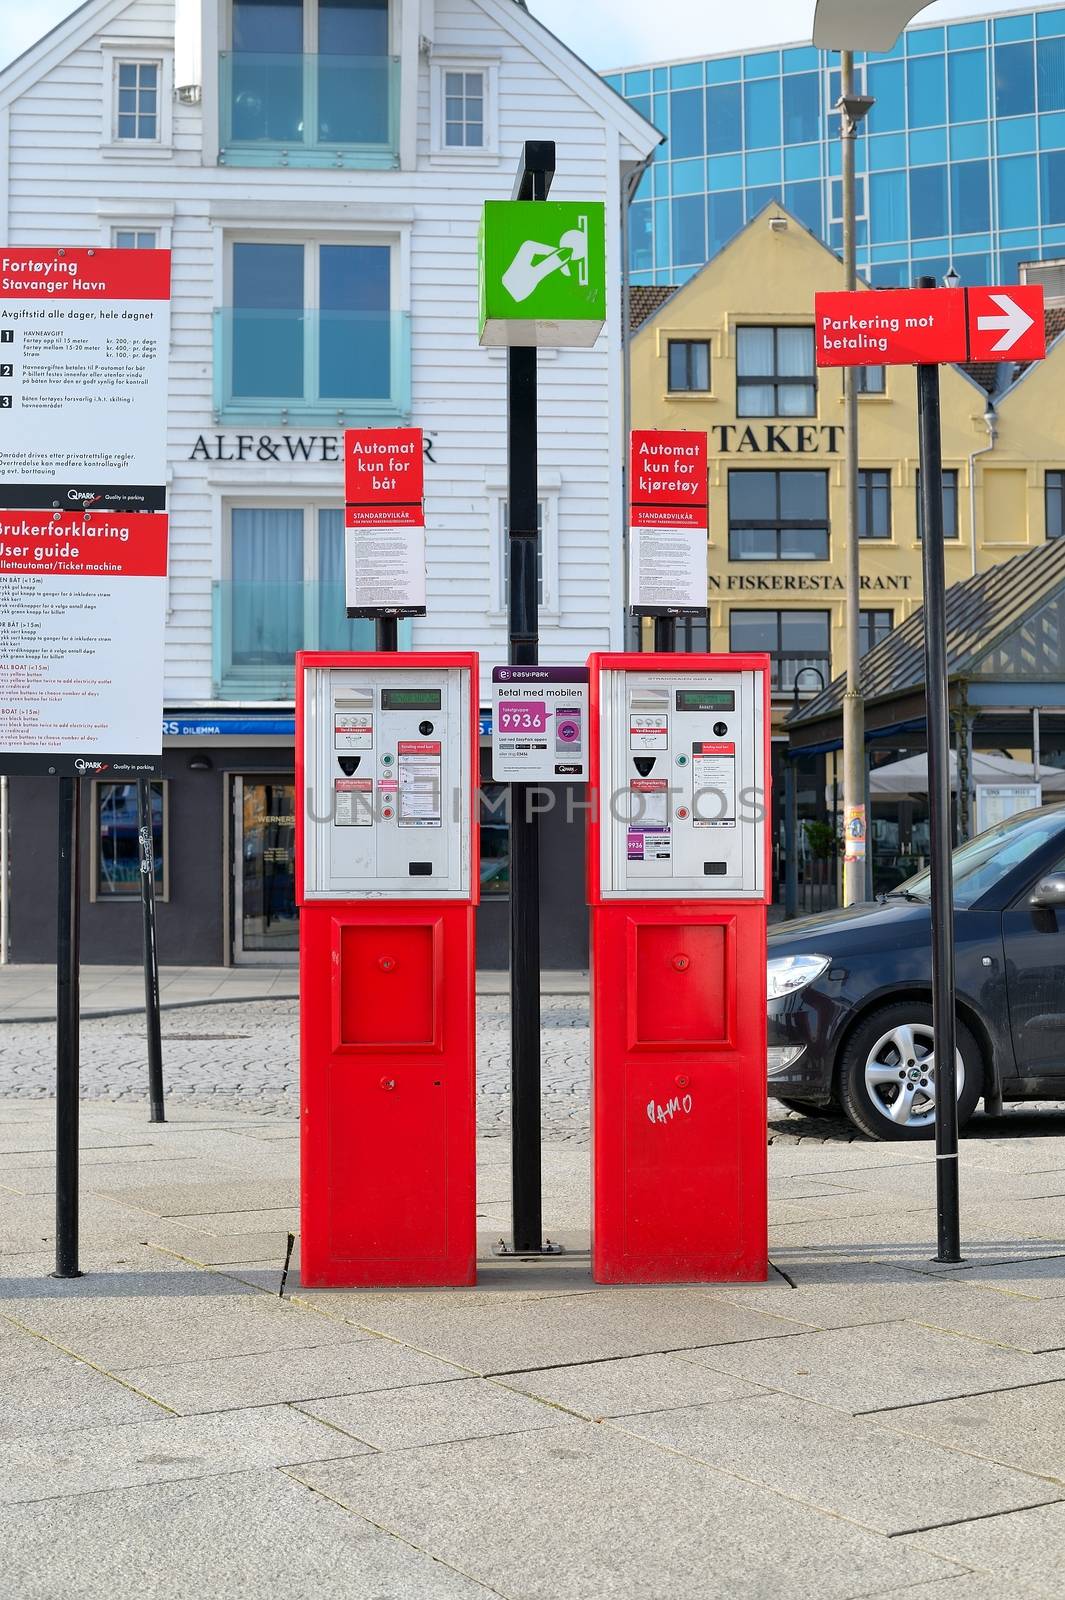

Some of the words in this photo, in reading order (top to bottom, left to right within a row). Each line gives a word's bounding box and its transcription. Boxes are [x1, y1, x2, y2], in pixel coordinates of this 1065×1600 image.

[2, 258, 78, 275] Fortøying
[2, 278, 68, 292] Stavanger
[73, 280, 106, 290] Havn
[1, 310, 45, 320] Avgiftstid
[48, 310, 66, 318] alle
[66, 311, 98, 320] dager,
[98, 310, 120, 319] hele
[120, 311, 153, 321] døgnet
[823, 316, 899, 332] Parkering
[906, 315, 934, 328] mot
[4, 332, 10, 340] 1
[824, 335, 888, 350] betaling
[3, 366, 10, 376] 2
[3, 397, 10, 407] 3
[712, 425, 844, 453] TAKET
[353, 442, 415, 454] Automat
[639, 442, 700, 456] Automat
[358, 458, 384, 472] kun
[389, 458, 410, 472] for
[644, 459, 669, 473] kun
[674, 460, 694, 473] for
[372, 476, 396, 490] båt
[639, 479, 699, 494] kjøretøy
[353, 511, 410, 519] STANDARDVILKÅR
[0, 521, 129, 541] rukerforklaring
[34, 544, 79, 560] guide
[86, 562, 122, 571] machine
[727, 575, 912, 590] FISKERESTARANT
[502, 714, 541, 727] 9936
